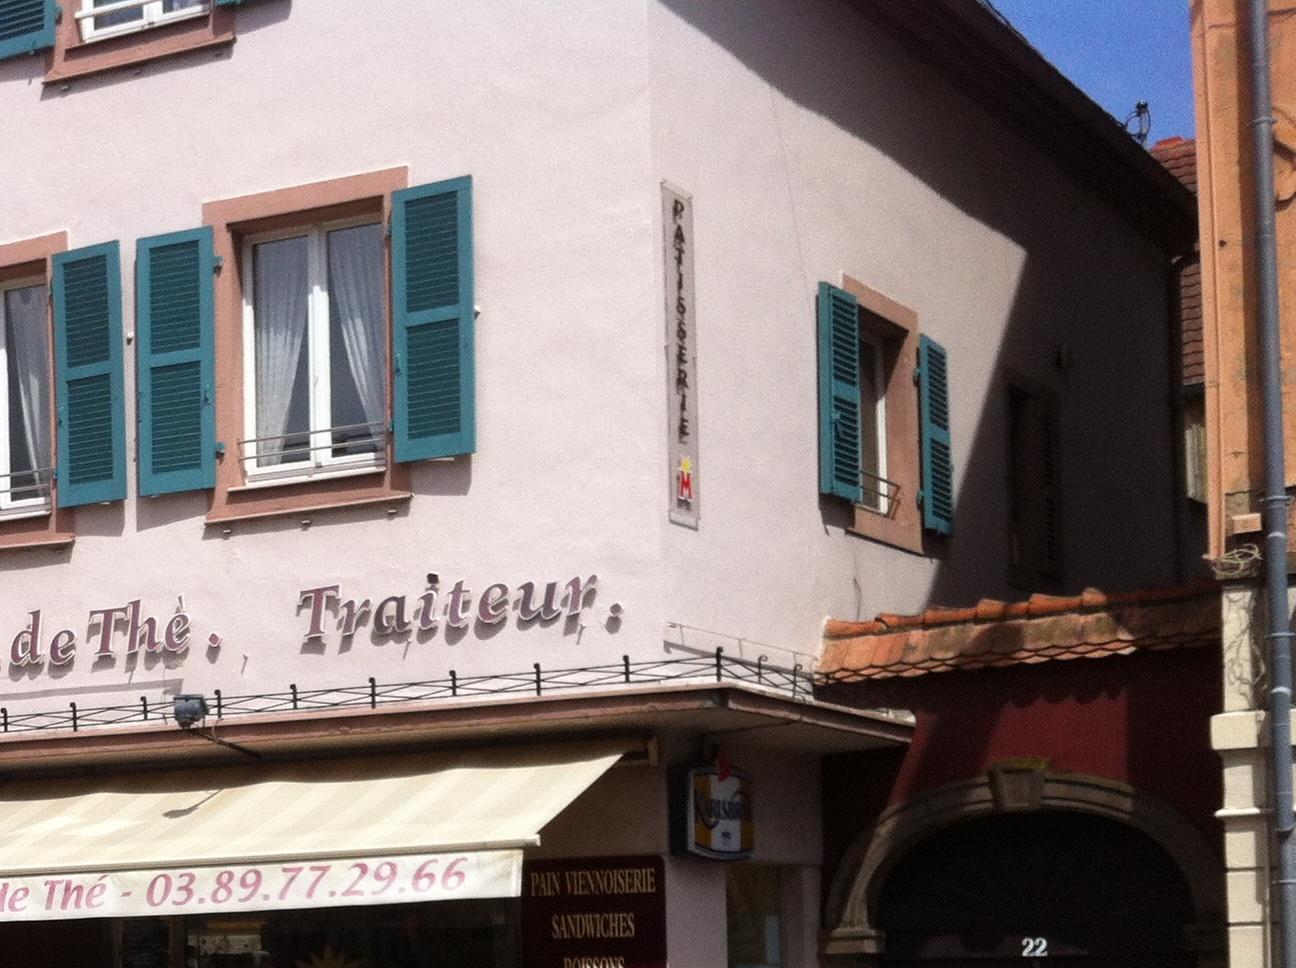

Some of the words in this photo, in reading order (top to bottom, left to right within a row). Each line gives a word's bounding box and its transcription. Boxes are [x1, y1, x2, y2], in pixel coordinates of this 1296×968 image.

[10, 609, 77, 667] de
[43, 874, 110, 912] Thé
[146, 857, 469, 908] 03.89.77.29.66
[531, 872, 561, 897] PAIN
[565, 868, 656, 895] VIENNOISERIE
[552, 912, 635, 939] SANDWICHES
[1021, 937, 1048, 957] 22
